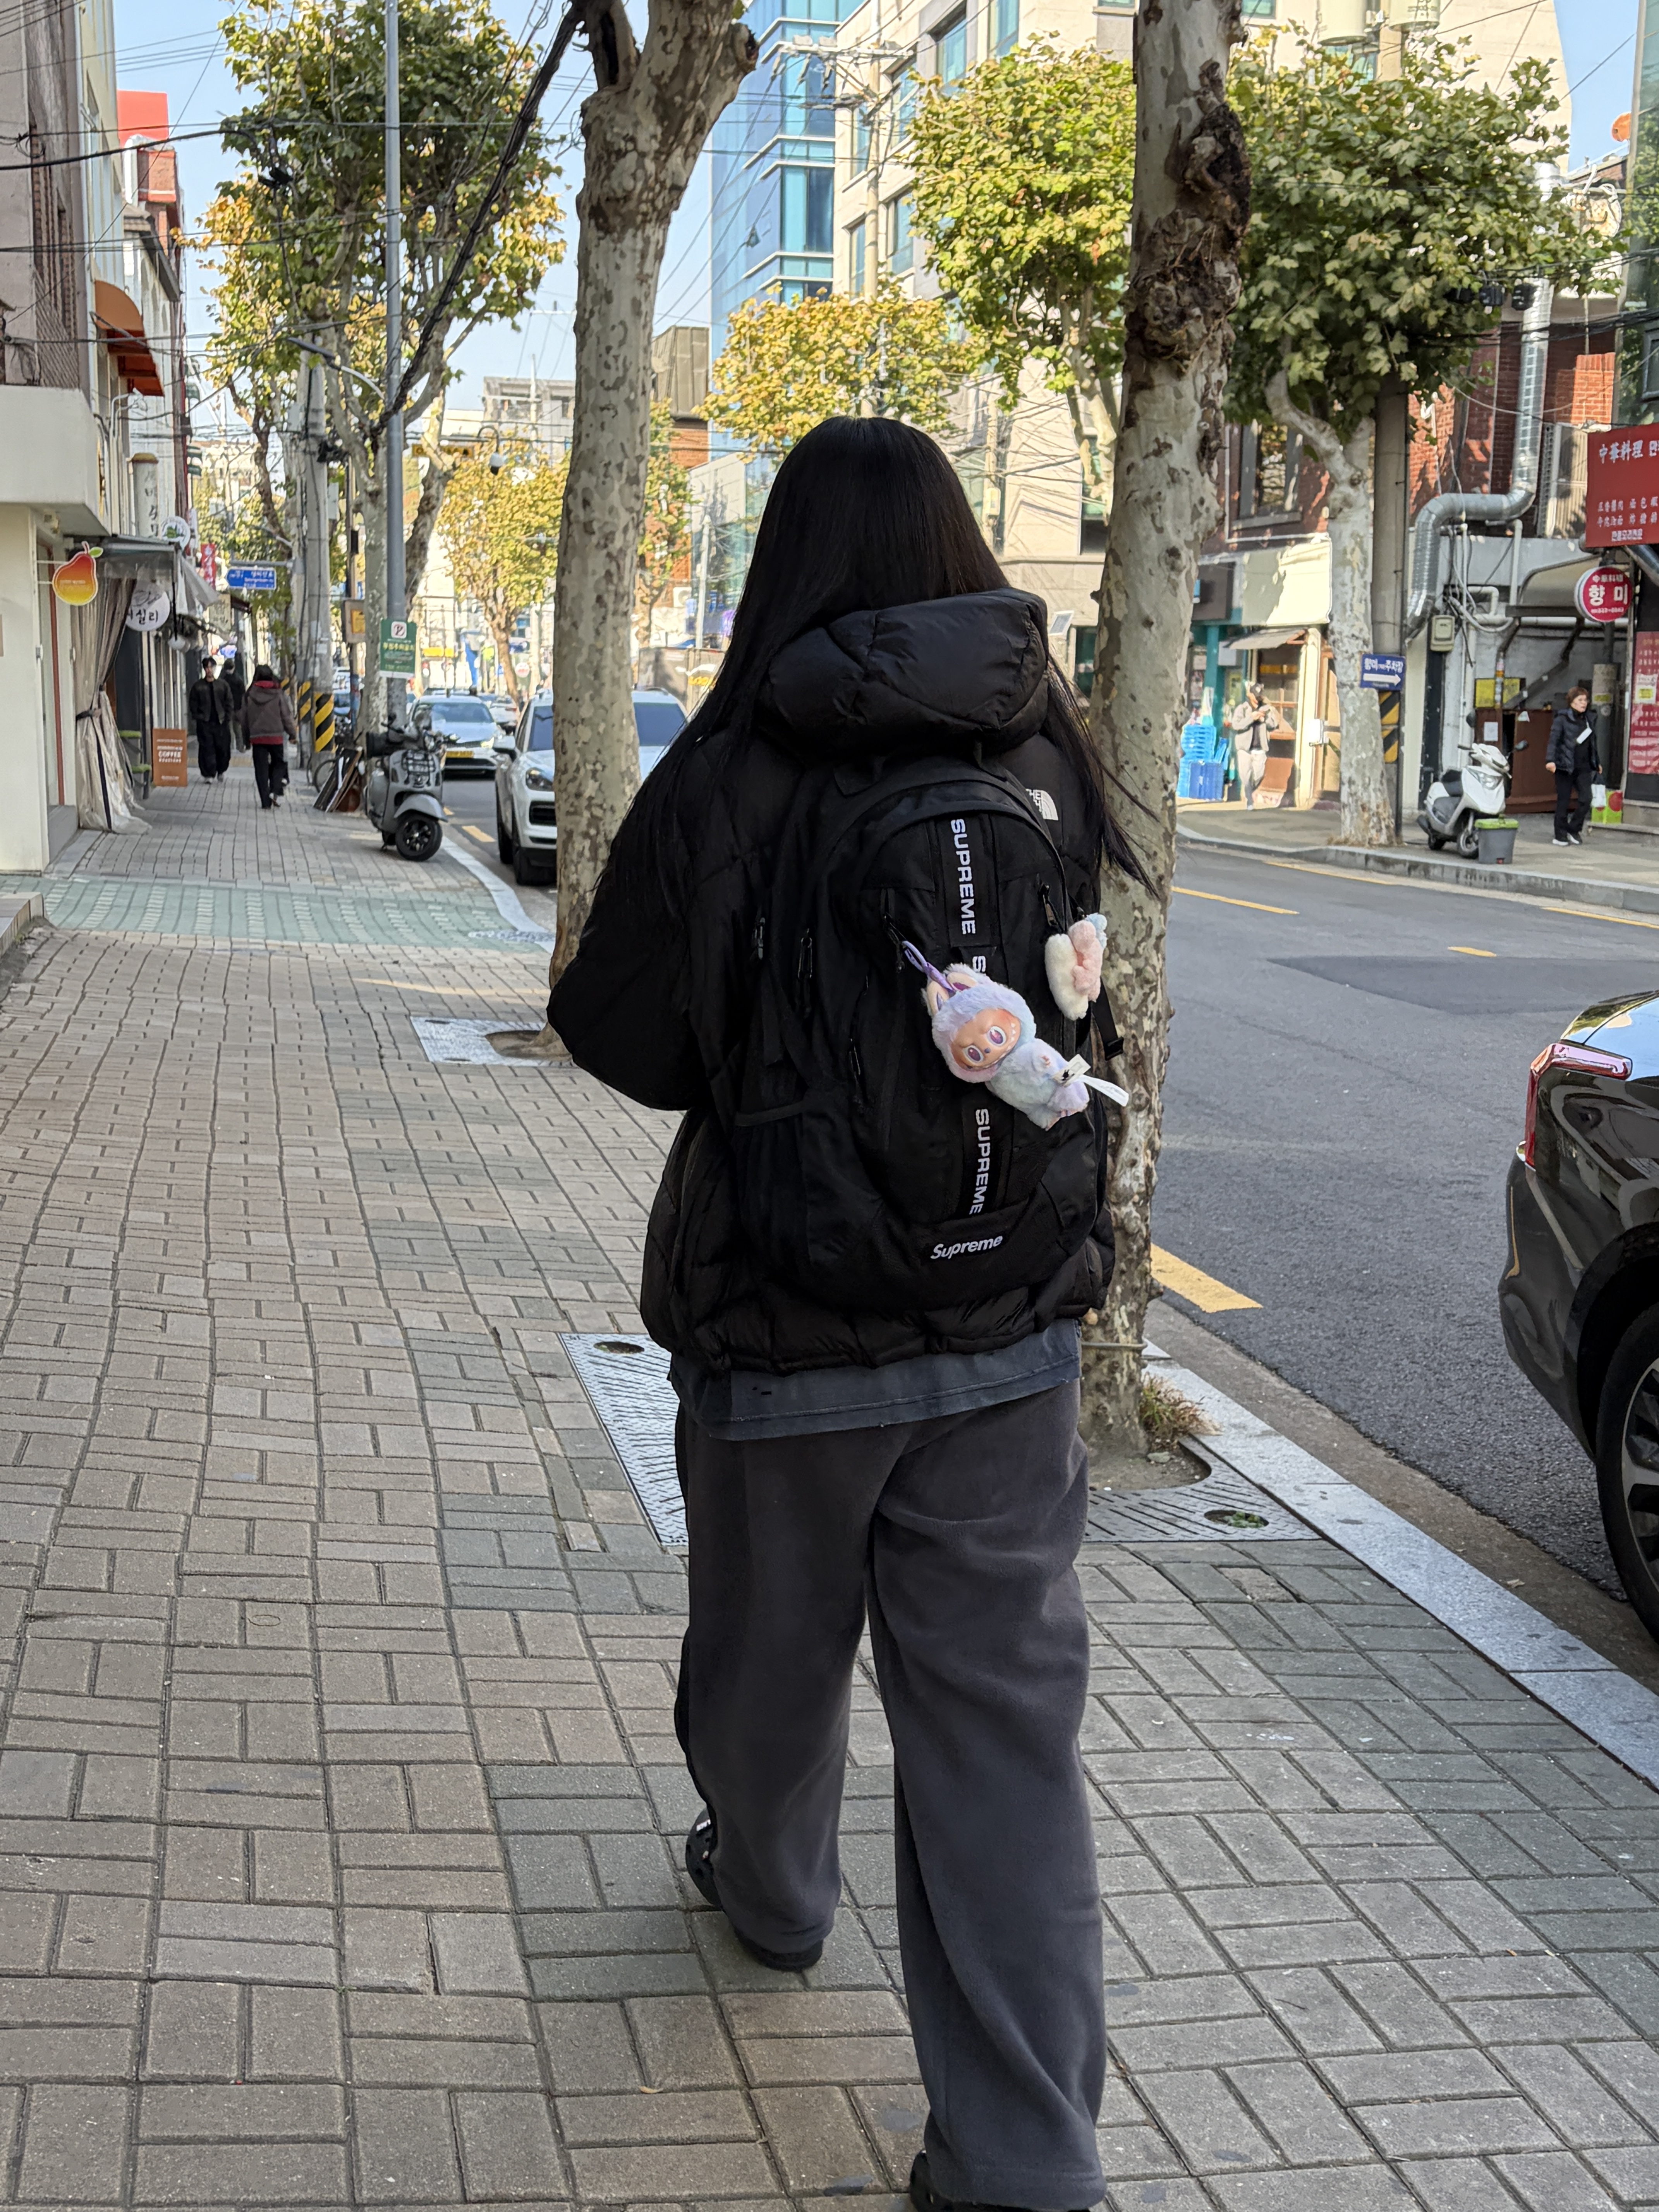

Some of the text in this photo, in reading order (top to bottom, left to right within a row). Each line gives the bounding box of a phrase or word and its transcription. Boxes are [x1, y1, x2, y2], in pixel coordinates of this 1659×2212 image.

[950, 818, 976, 935] SUPREME
[969, 1108, 990, 1215] SUPREME
[931, 1235, 1003, 1260] Supreme
